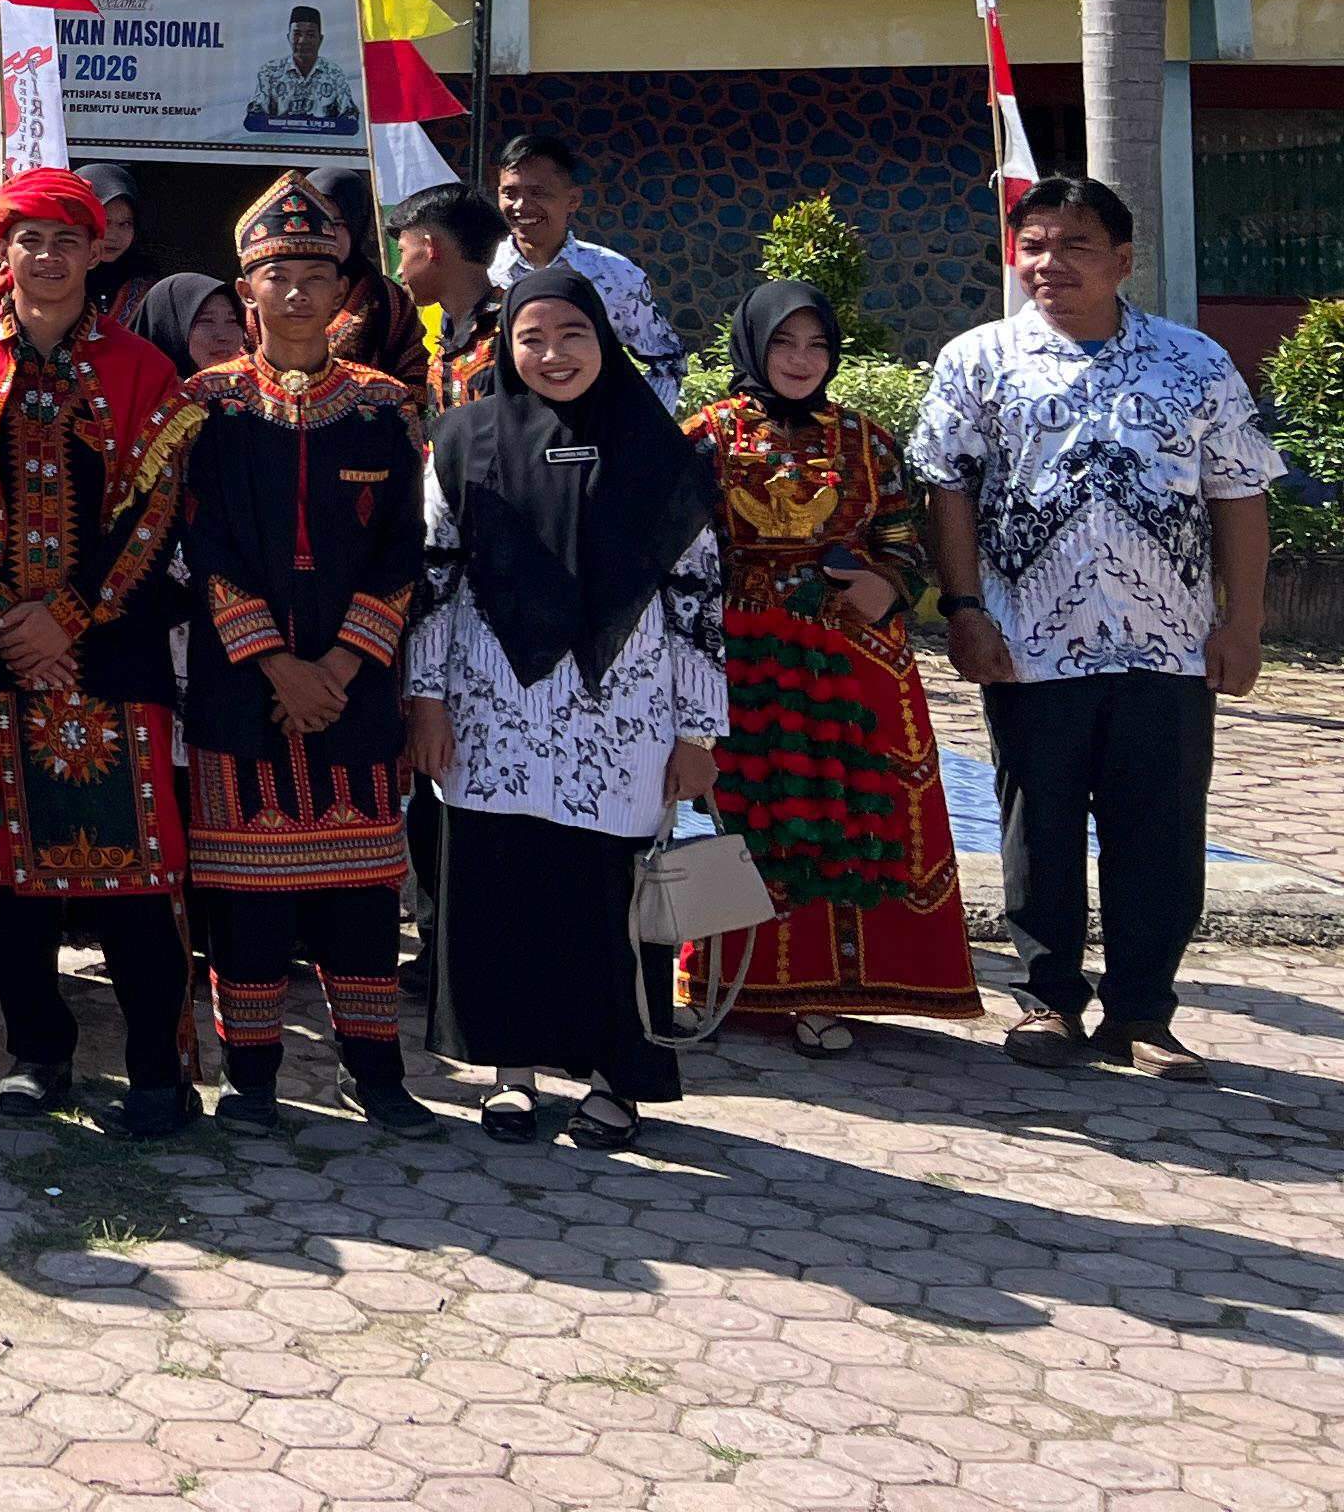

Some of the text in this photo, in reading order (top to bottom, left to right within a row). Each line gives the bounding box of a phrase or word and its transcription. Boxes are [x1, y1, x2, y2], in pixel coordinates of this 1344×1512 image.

[113, 20, 224, 48] NASIONAL
[75, 55, 137, 81] 2026
[114, 91, 162, 101] SEMESTA
[69, 104, 120, 114] BERMUTU
[122, 105, 159, 115] UNTUK
